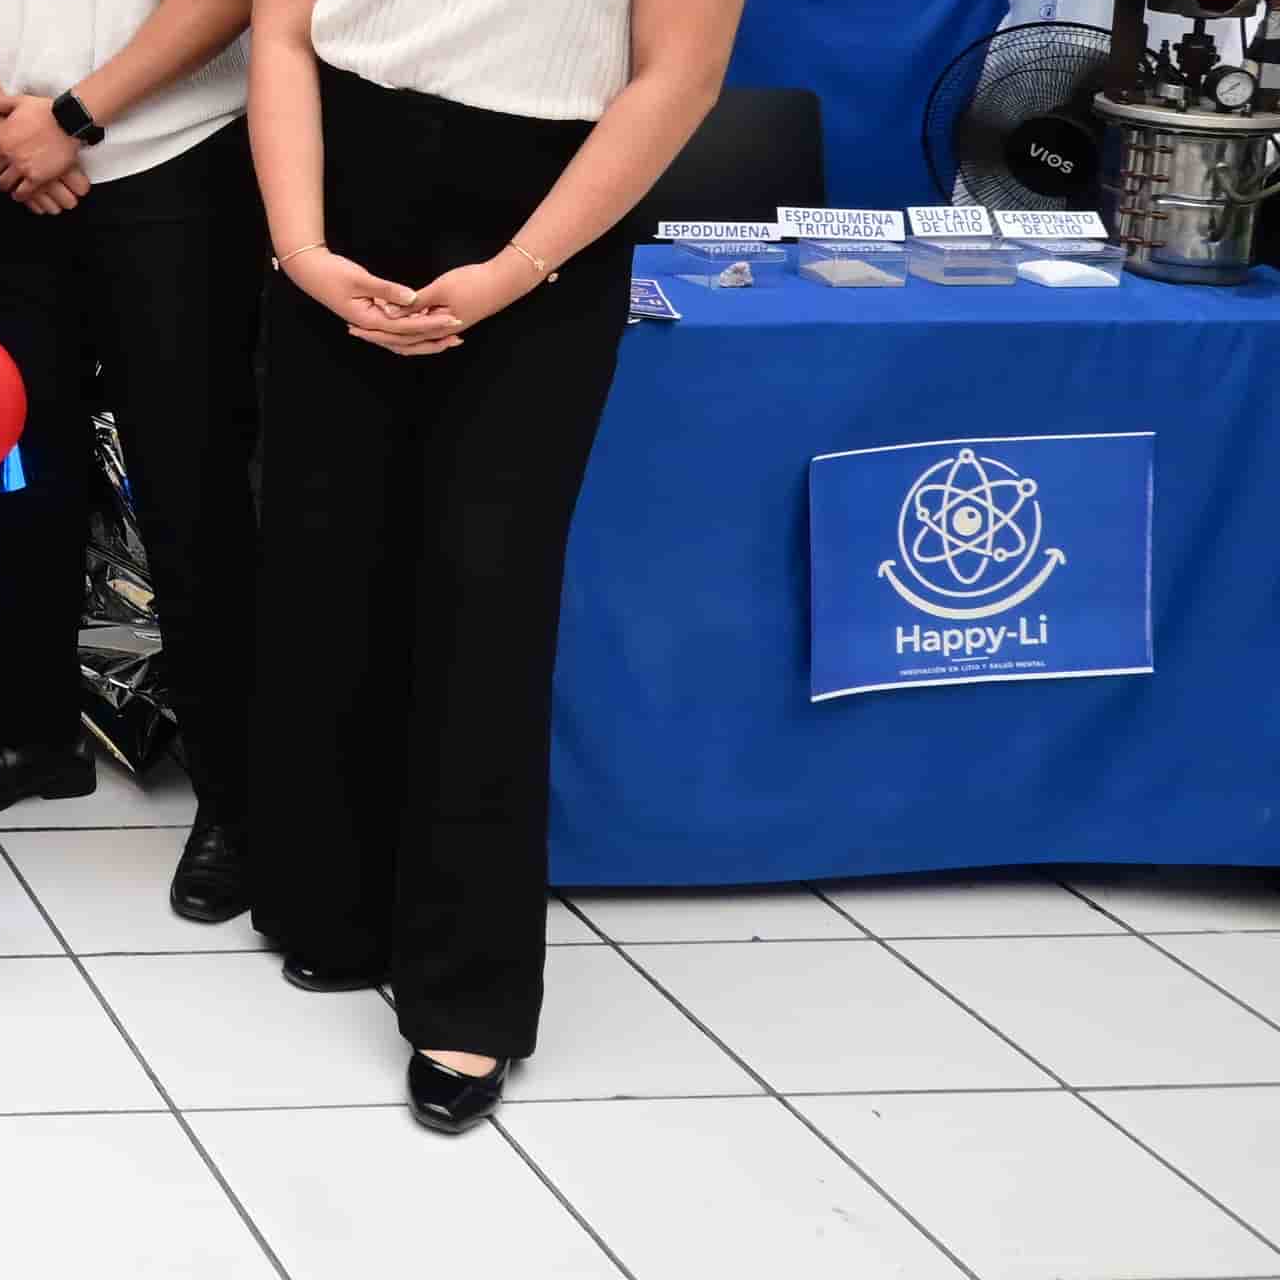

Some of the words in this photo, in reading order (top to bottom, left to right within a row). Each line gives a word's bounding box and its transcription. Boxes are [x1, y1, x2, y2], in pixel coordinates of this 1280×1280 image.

[1029, 143, 1075, 175] VIOS
[784, 209, 895, 226] ESPODUMENA
[915, 208, 982, 222] SULFATO
[1001, 213, 1095, 226] CARBONATO
[663, 223, 771, 239] ESPODUMENA
[796, 222, 886, 238] TRITURADA
[922, 221, 941, 233] DE
[946, 221, 983, 233] LITIO
[1023, 224, 1043, 235] DE
[1046, 224, 1084, 235] LITIO
[895, 614, 1049, 657] Happy-Li
